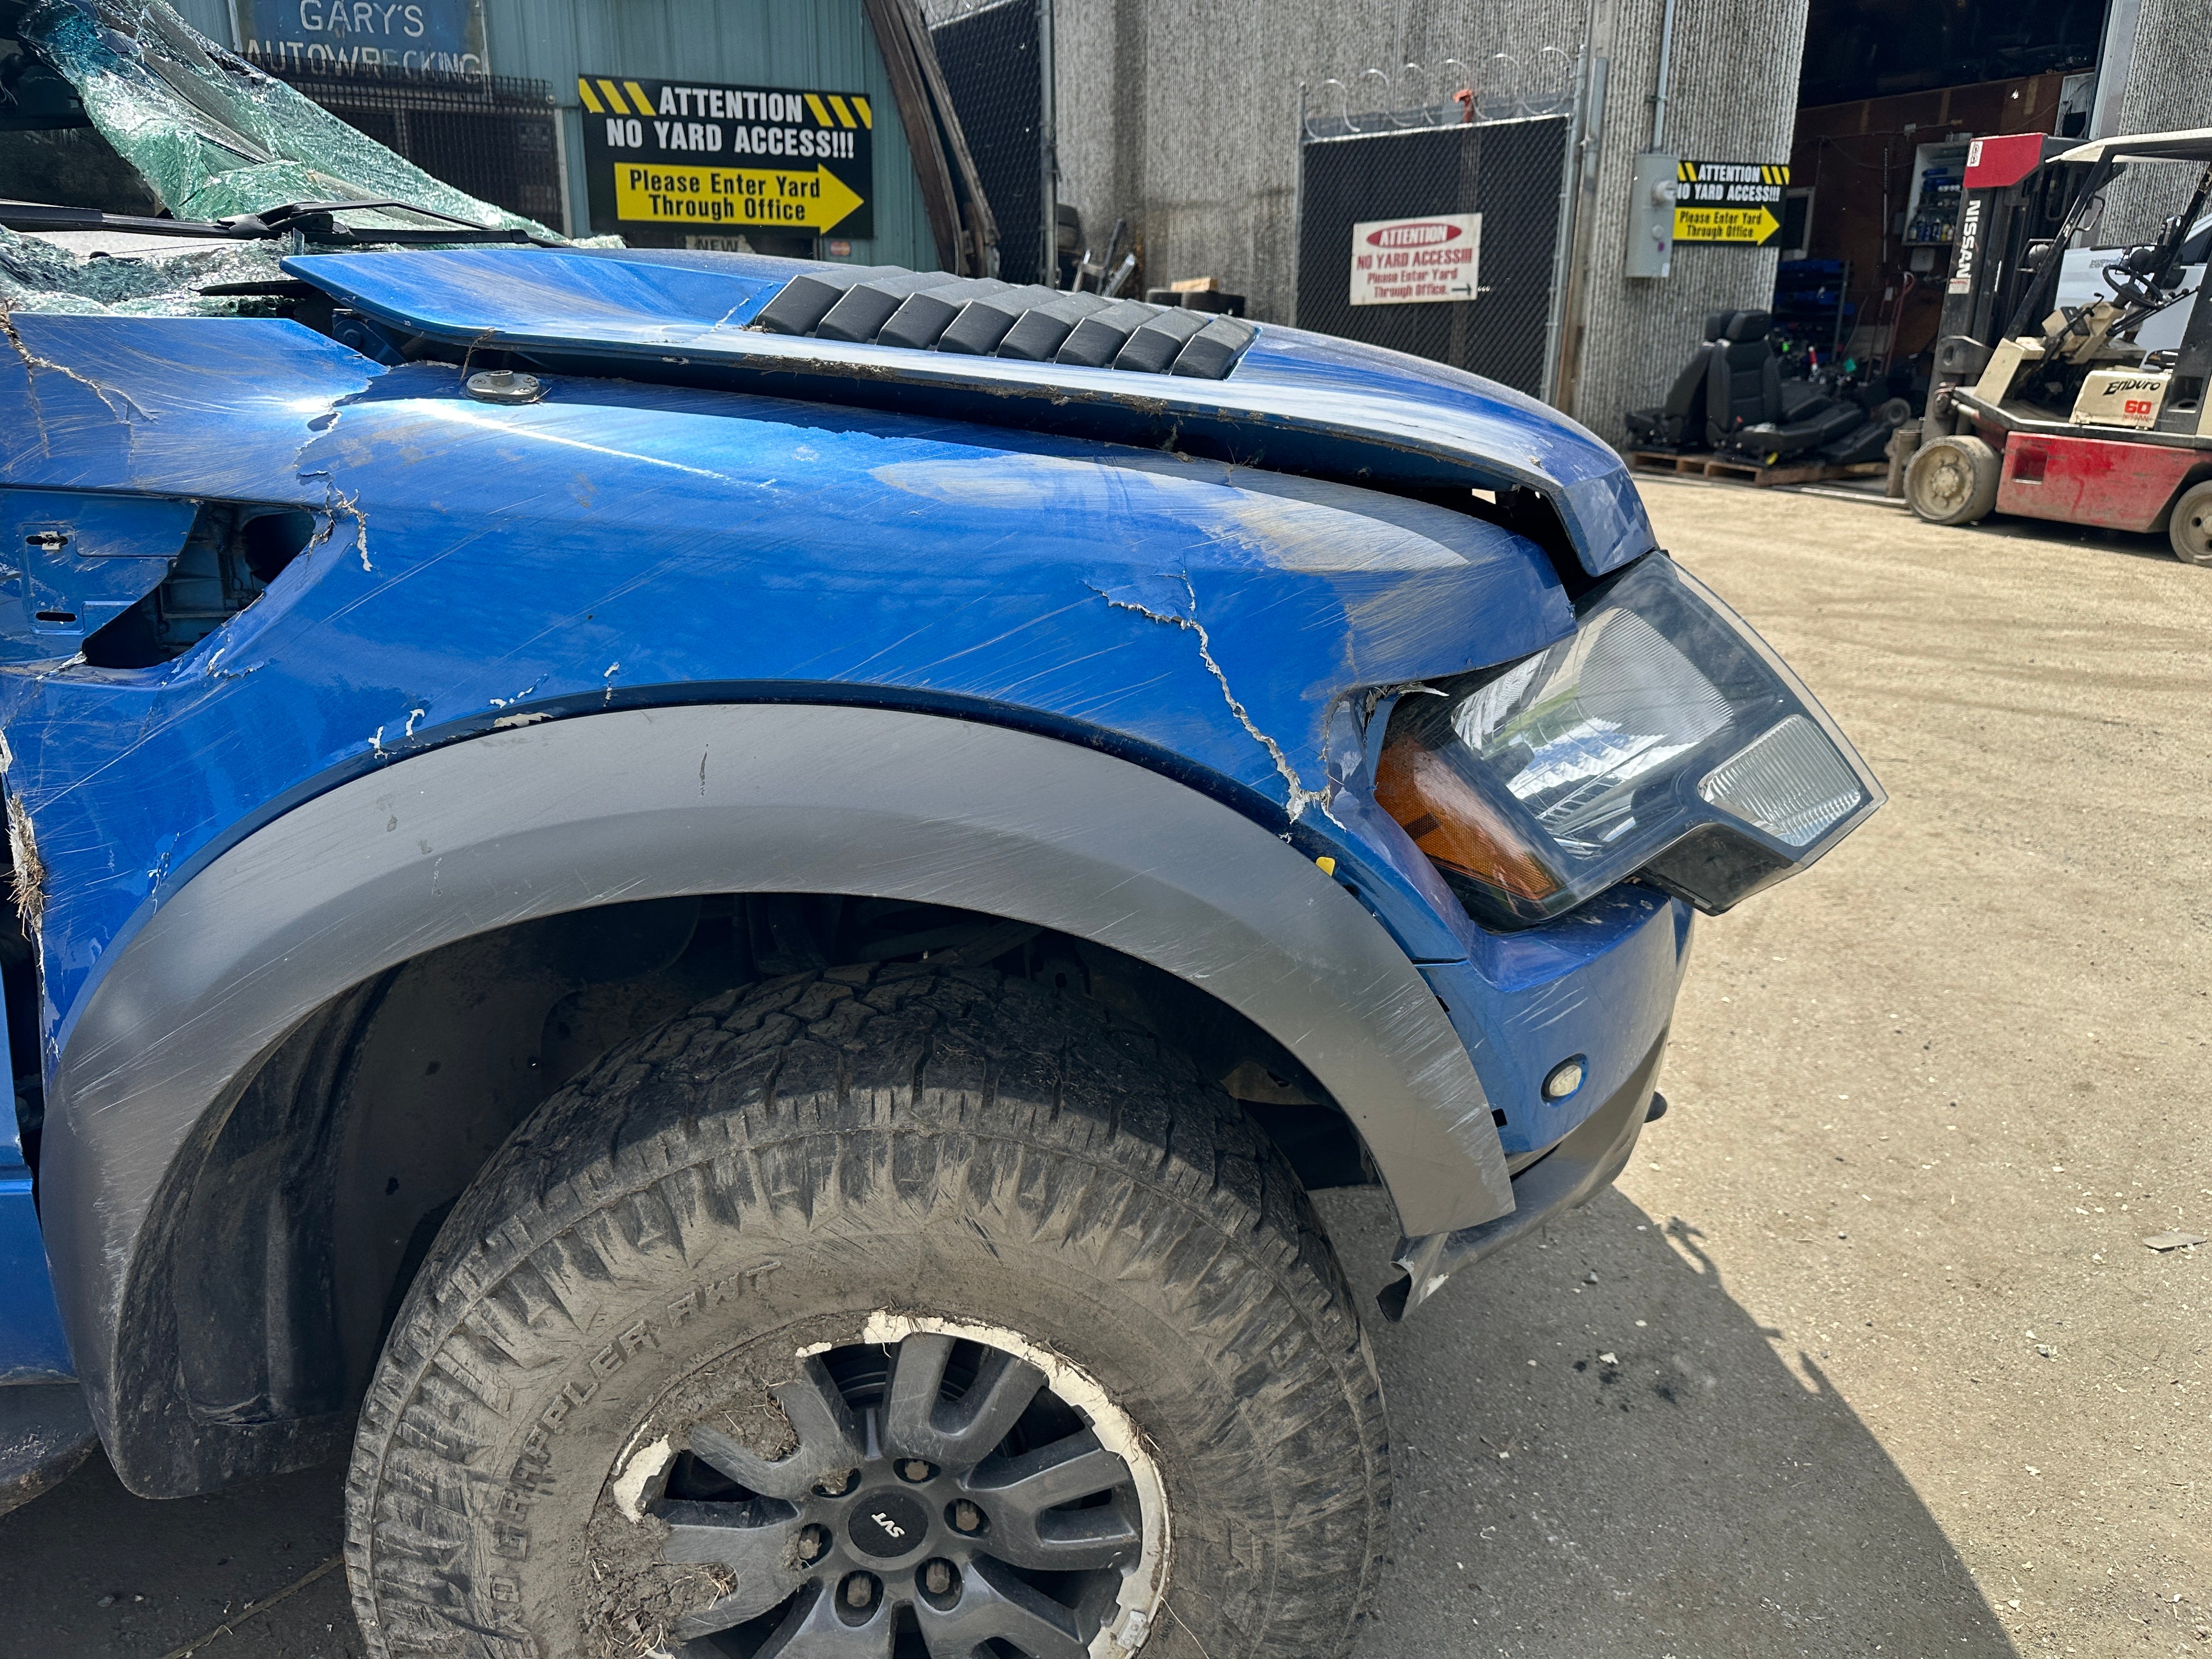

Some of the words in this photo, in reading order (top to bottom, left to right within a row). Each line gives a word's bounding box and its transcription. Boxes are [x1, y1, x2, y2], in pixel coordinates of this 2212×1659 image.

[301, 0, 425, 37] GARY'S
[658, 86, 803, 123] ATTENTION
[606, 118, 643, 148] NO
[654, 121, 722, 151] YARD
[734, 126, 855, 159] ACCESS!!!
[630, 169, 700, 193] Please
[711, 172, 766, 195] Enter
[776, 176, 820, 198] Yard
[1698, 164, 1760, 183] ATTENTION
[1694, 184, 1724, 201] YARD
[1726, 184, 1781, 202] ACCESS!!!
[649, 195, 734, 221] Through
[745, 198, 805, 220] Office
[1680, 211, 1710, 223] Please
[1713, 211, 1738, 223] Enter
[1743, 212, 1762, 225] Yard
[1379, 225, 1448, 247] ATTENTION
[1686, 225, 1722, 239] Through
[1726, 226, 1753, 238] Office
[1956, 200, 1981, 279] NISSAN
[695, 237, 738, 252] NEW
[1357, 256, 1372, 271] NO
[1377, 253, 1408, 268] YARD
[1412, 248, 1472, 266] ACCESS!!!
[1368, 272, 1397, 284] Please
[1400, 270, 1428, 281] Enter
[1432, 268, 1458, 280] Yard
[1374, 286, 1412, 298] Through
[2124, 400, 2152, 414] 60
[871, 1512, 905, 1537] SVT
